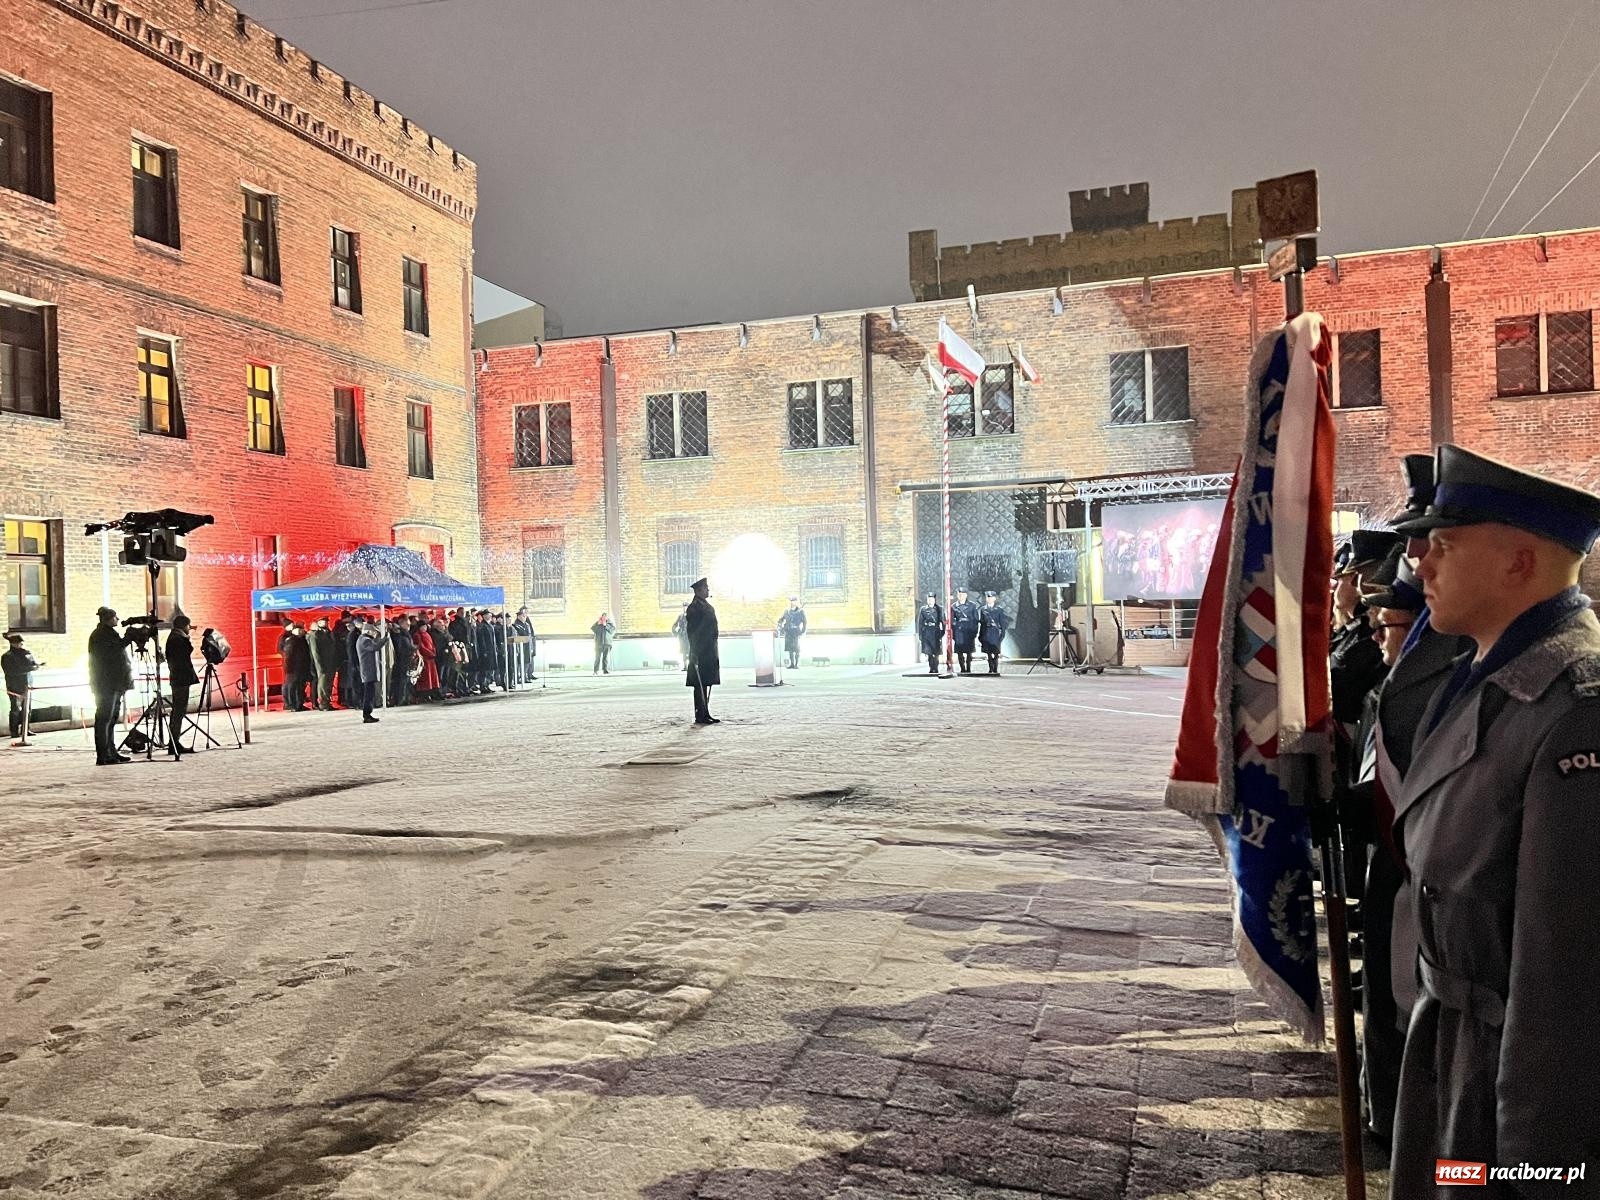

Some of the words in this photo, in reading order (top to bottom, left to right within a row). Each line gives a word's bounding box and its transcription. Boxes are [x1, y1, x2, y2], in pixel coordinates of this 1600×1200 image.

[302, 592, 329, 602] SŁUŻBA
[331, 592, 374, 602] WIĘZIENNA
[1558, 752, 1600, 774] POL
